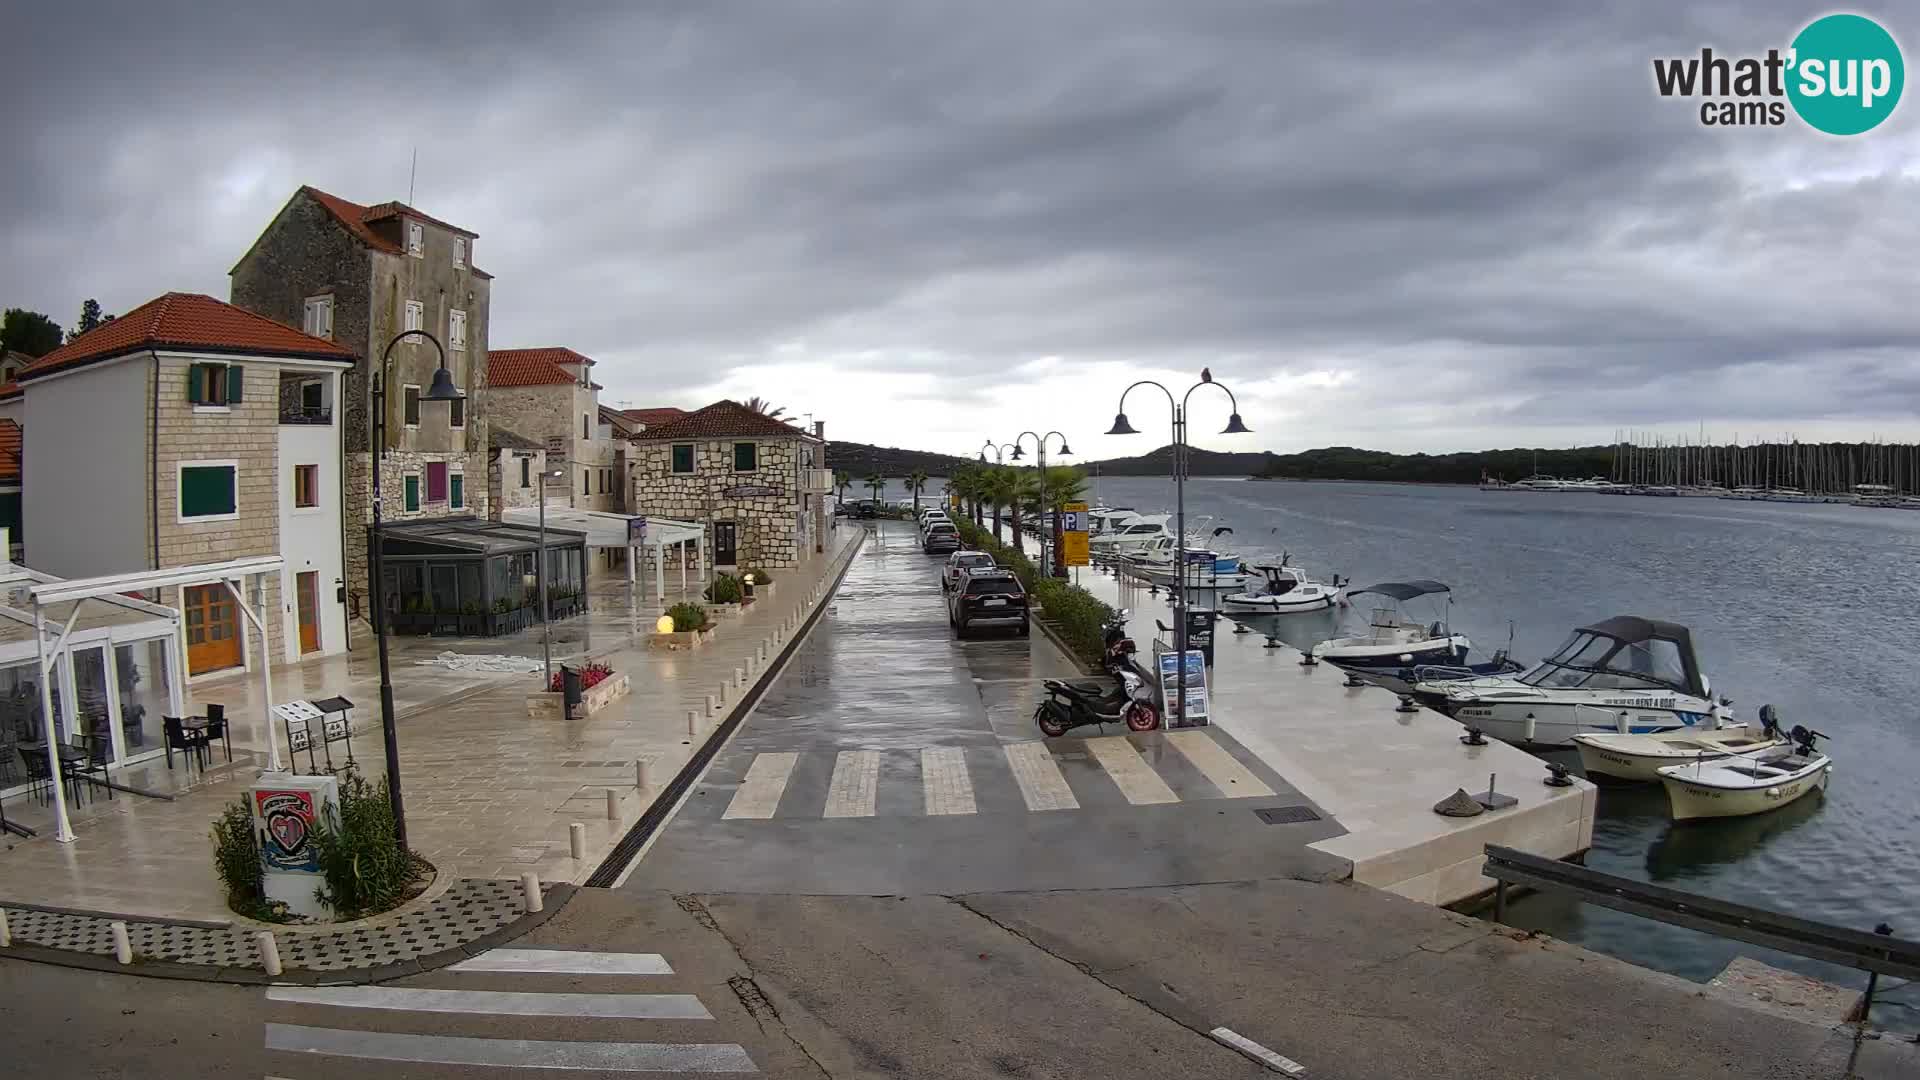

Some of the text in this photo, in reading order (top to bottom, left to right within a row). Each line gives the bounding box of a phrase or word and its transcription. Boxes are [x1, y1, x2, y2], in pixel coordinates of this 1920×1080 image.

[1065, 513, 1076, 530] P
[1636, 698, 1653, 708] RENT
[1654, 698, 1659, 708] A
[1660, 698, 1677, 709] BOAT
